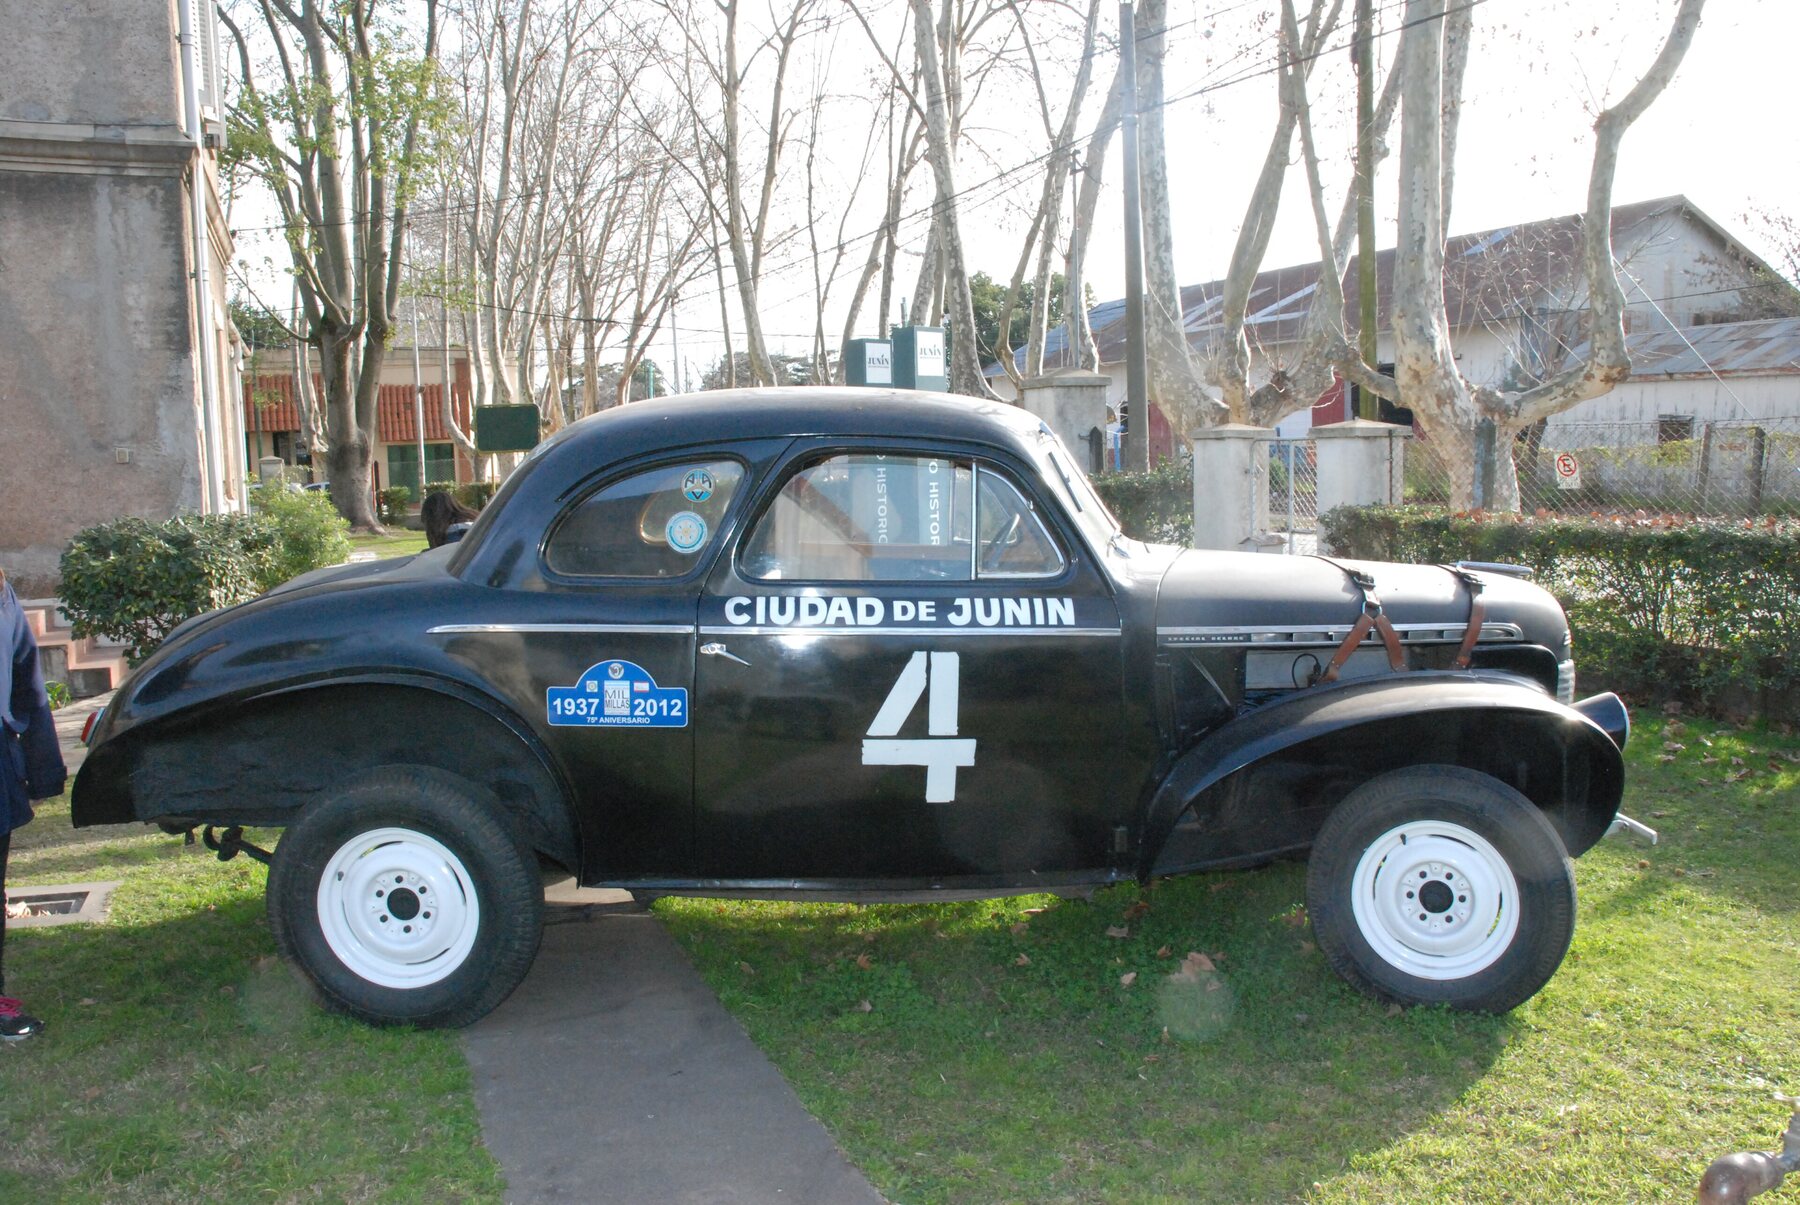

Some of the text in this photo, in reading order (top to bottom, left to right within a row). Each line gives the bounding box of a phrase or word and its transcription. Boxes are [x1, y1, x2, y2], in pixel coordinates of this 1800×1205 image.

[724, 596, 1076, 626] CIUDAD DE JUNIN
[605, 689, 629, 699] MIL
[552, 698, 600, 715] 1937
[604, 699, 630, 709] MILLAS
[634, 699, 682, 716] 2012
[862, 651, 977, 803] 4
